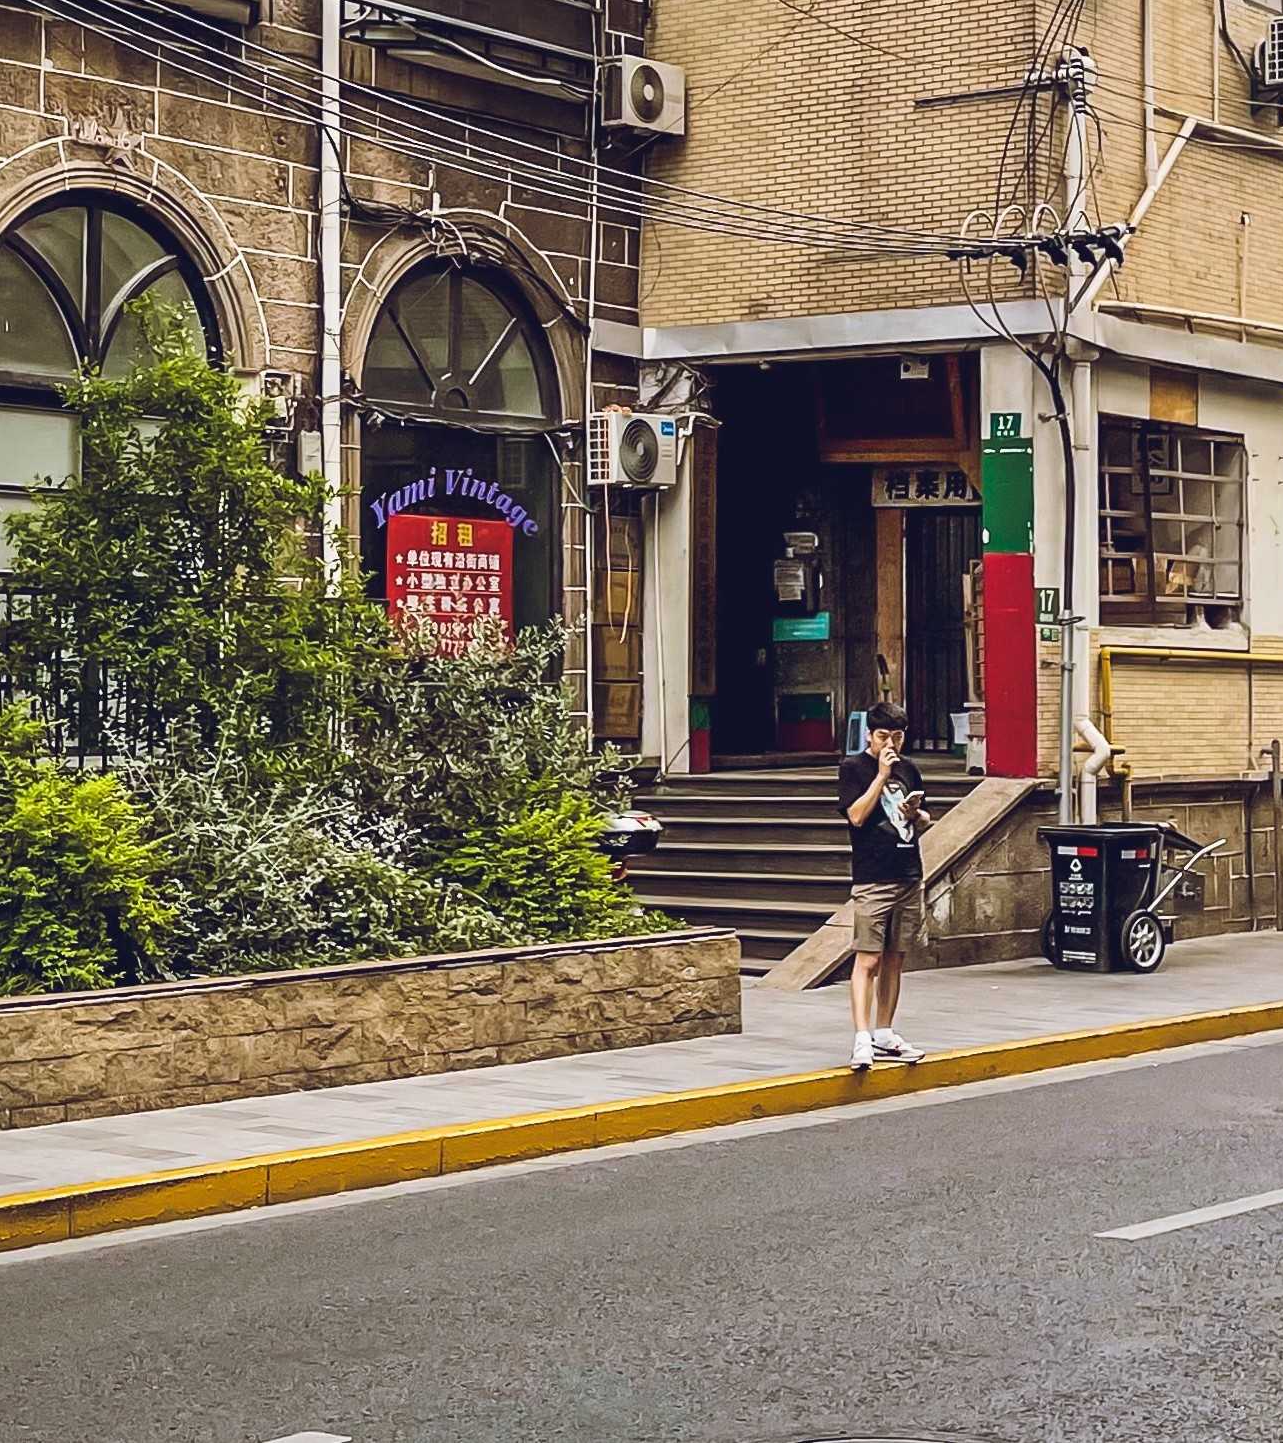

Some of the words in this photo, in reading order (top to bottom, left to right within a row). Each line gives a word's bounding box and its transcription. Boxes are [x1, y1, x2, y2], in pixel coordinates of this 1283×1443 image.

[997, 415, 1014, 430] 17
[370, 466, 437, 529] Yami
[445, 467, 539, 537] Vintage
[1039, 589, 1055, 612] 17
